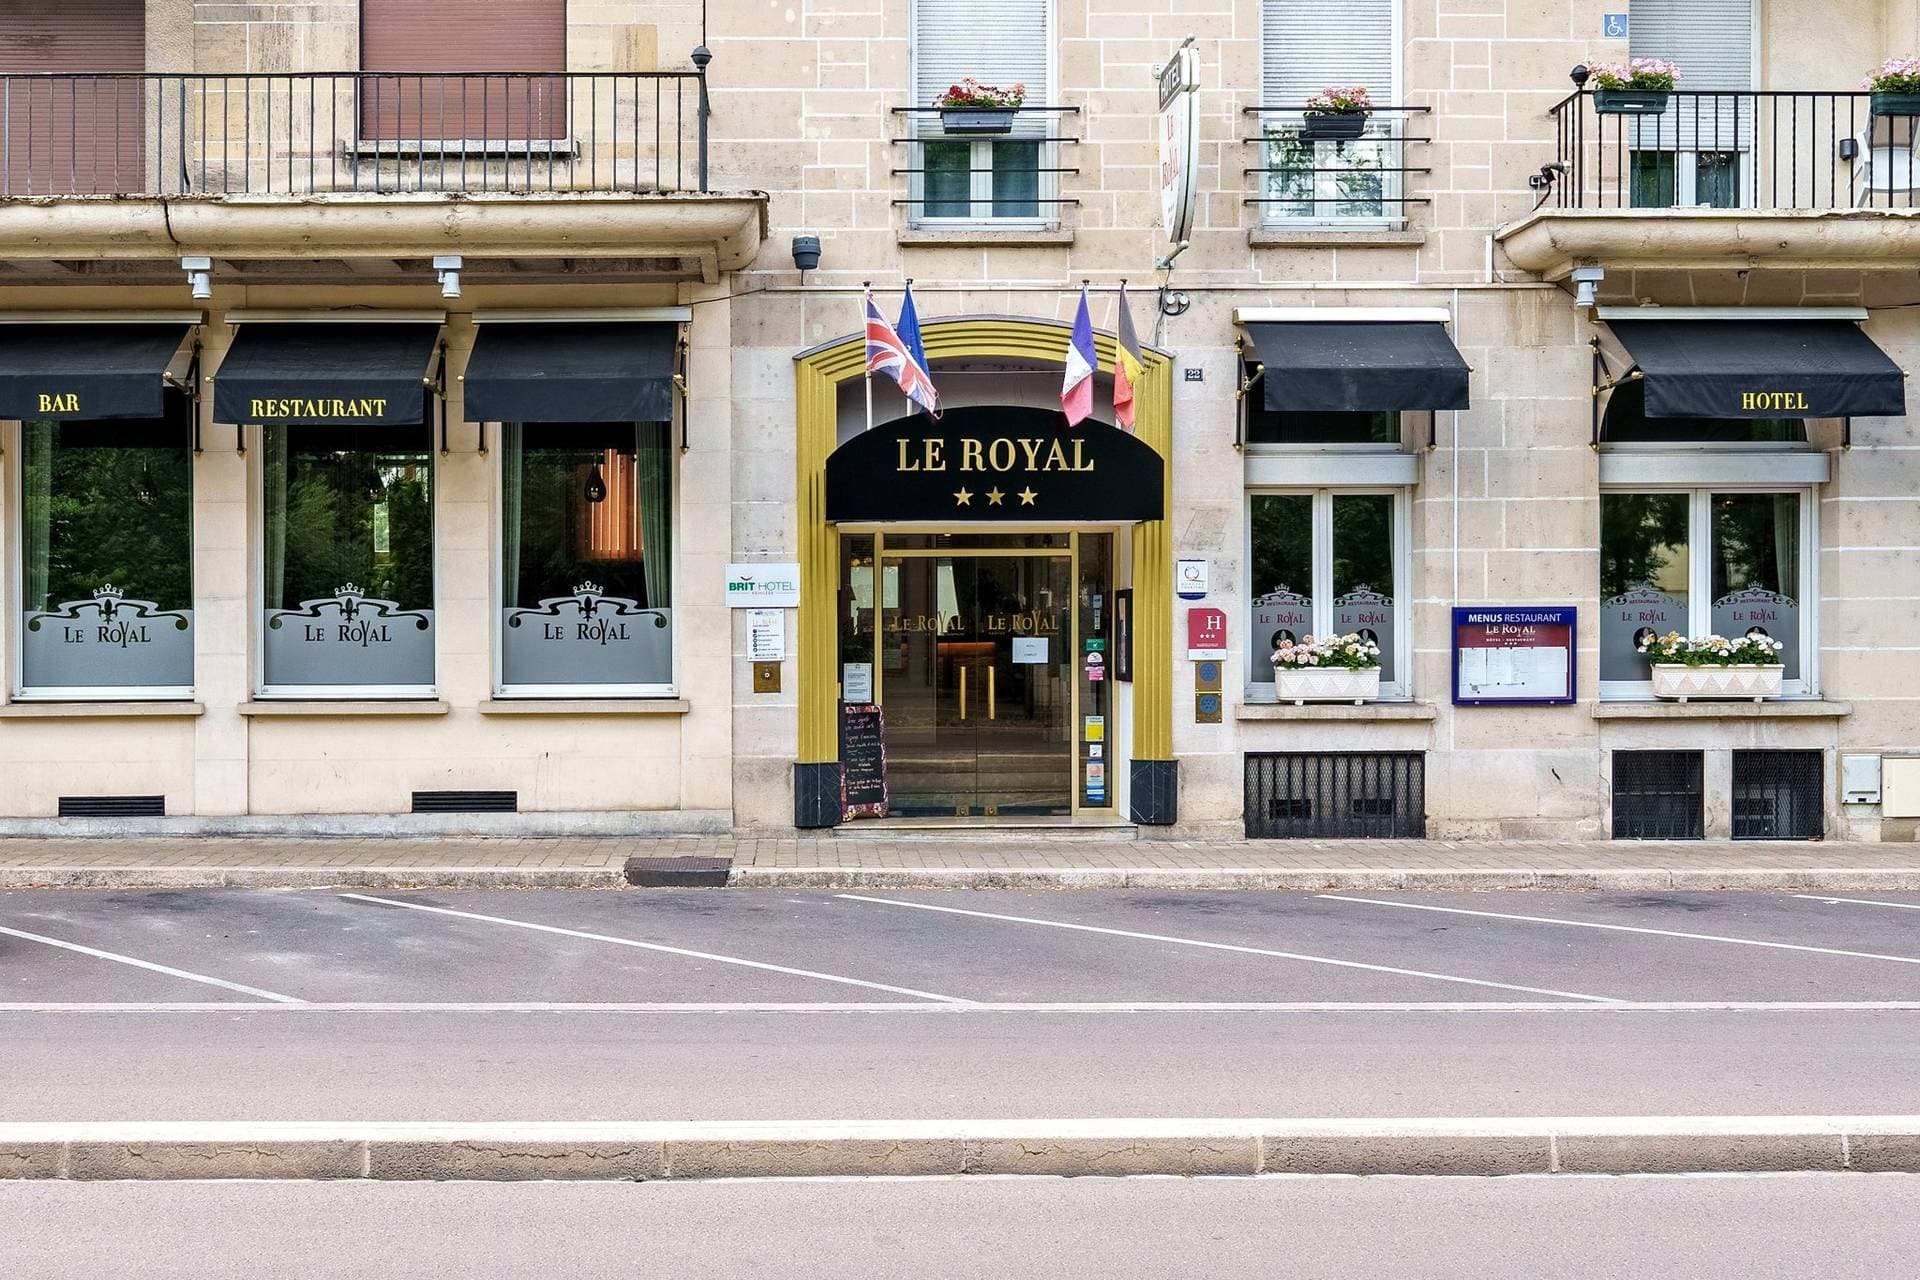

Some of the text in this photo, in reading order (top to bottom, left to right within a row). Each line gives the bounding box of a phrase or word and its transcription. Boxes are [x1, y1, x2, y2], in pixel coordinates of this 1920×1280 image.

[1187, 369, 1201, 378] 22
[38, 393, 80, 412] BAR
[251, 398, 387, 418] RESTAURANT
[1742, 392, 1809, 410] HOTEL
[896, 438, 1095, 472] LE ROYAL
[729, 581, 797, 591] BRIT HOTEL
[893, 615, 912, 630] LE
[988, 609, 1060, 636] LE ROYAL
[1207, 615, 1222, 630] H
[1260, 611, 1305, 626] LE ROYAL
[1341, 611, 1387, 625] LE ROYAL
[1468, 613, 1562, 623] MENUS RESTAURANT
[1622, 609, 1667, 624] LE ROYAL
[1733, 609, 1778, 623] LE ROYAL
[64, 621, 151, 648] LE ROYAL
[304, 620, 391, 647] LE ROYAL
[544, 618, 630, 645] LE ROYAL
[1486, 624, 1499, 634] LE
